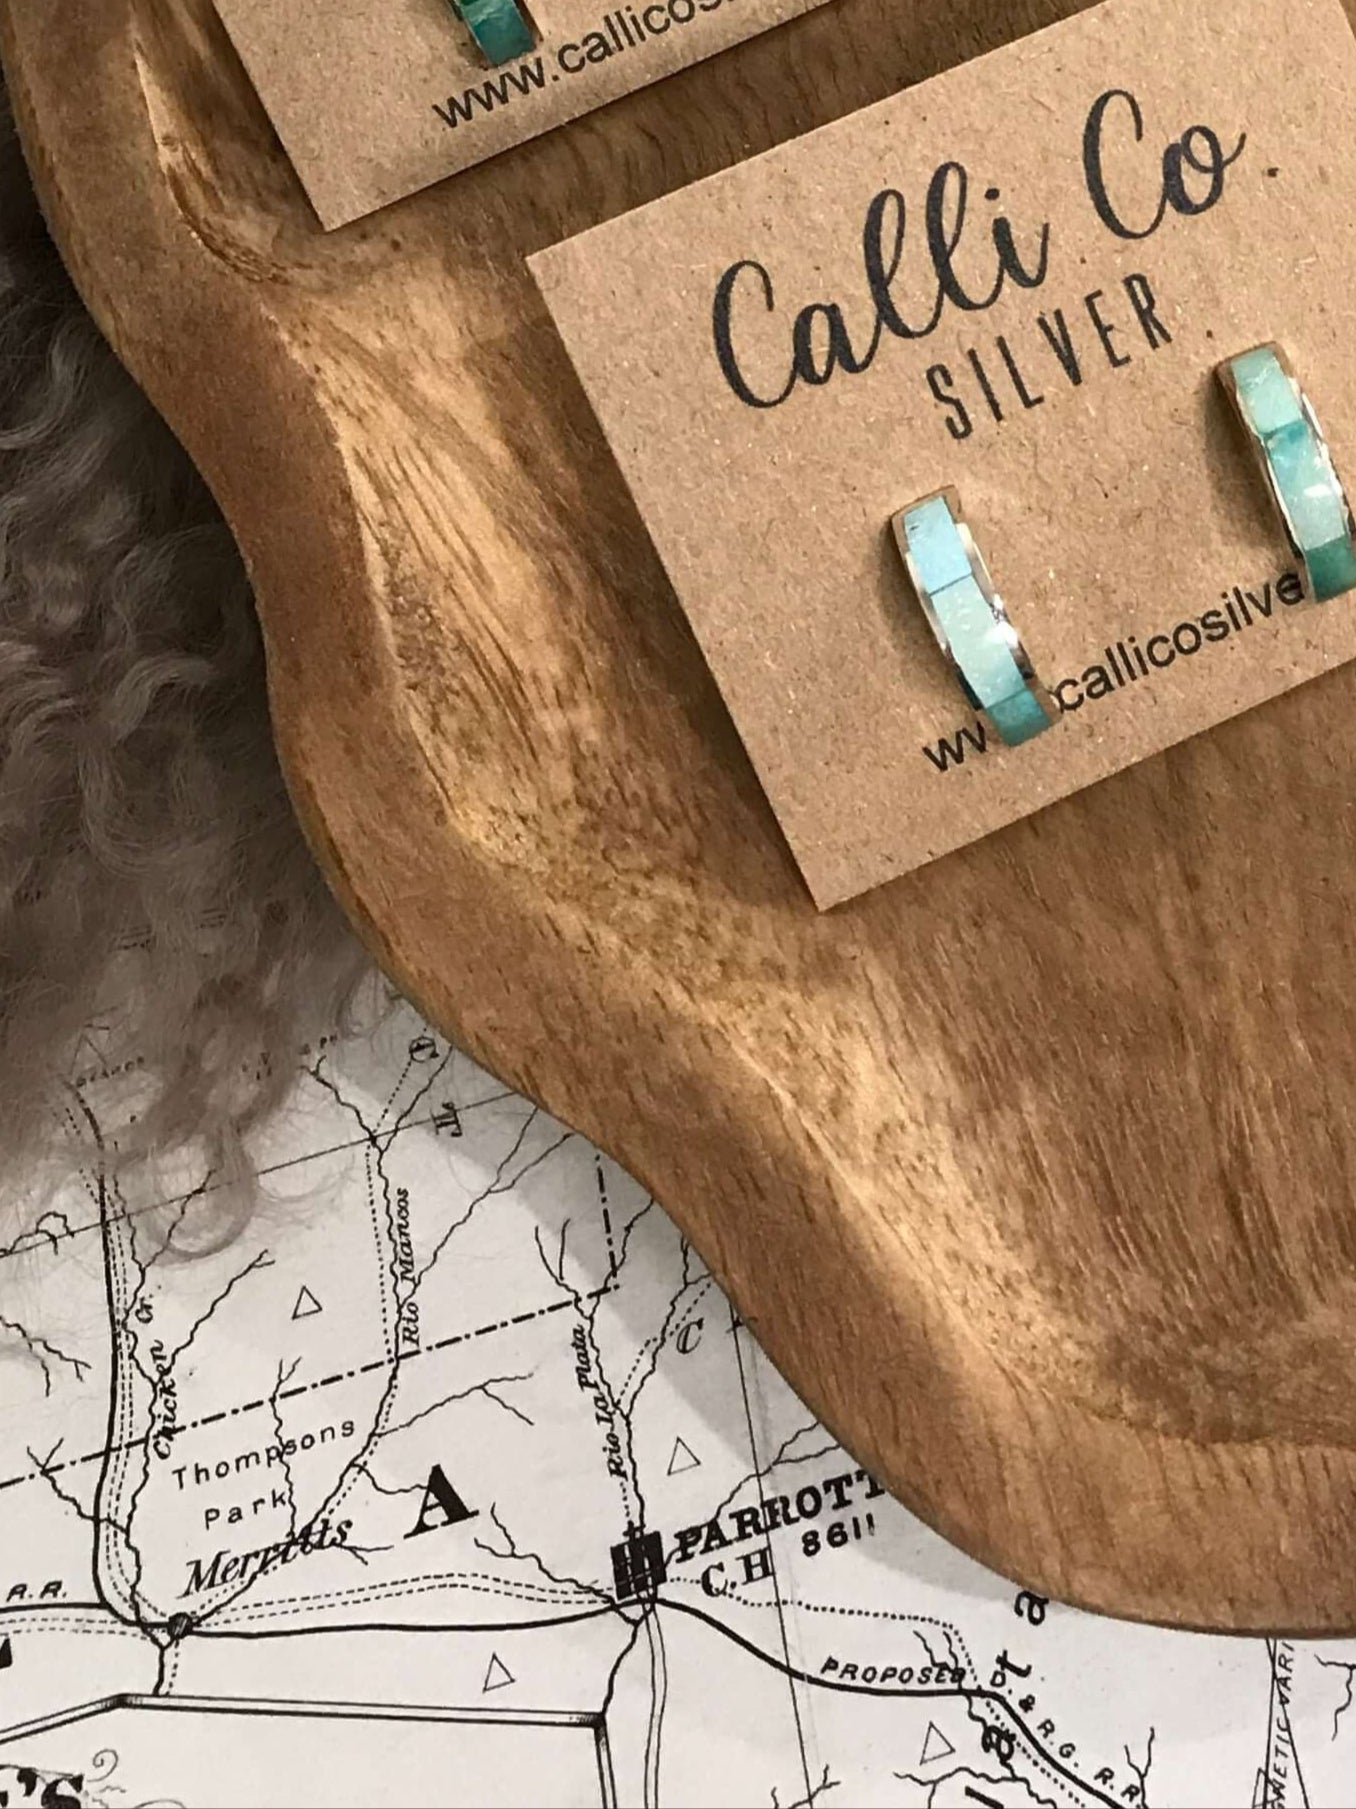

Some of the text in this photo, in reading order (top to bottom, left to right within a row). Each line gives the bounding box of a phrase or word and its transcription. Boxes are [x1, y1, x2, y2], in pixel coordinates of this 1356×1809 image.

[712, 89, 1279, 409] Calli Co.
[926, 273, 1172, 440] SILVER
[396, 1187, 420, 1347] Rio Mancos
[570, 1323, 600, 1392] Plata
[149, 1339, 179, 1461] Chicken
[172, 1419, 355, 1490] Thompsons
[602, 1432, 629, 1482] Rio
[204, 1489, 288, 1530] Park
[819, 1655, 967, 1685] PROPOSED
